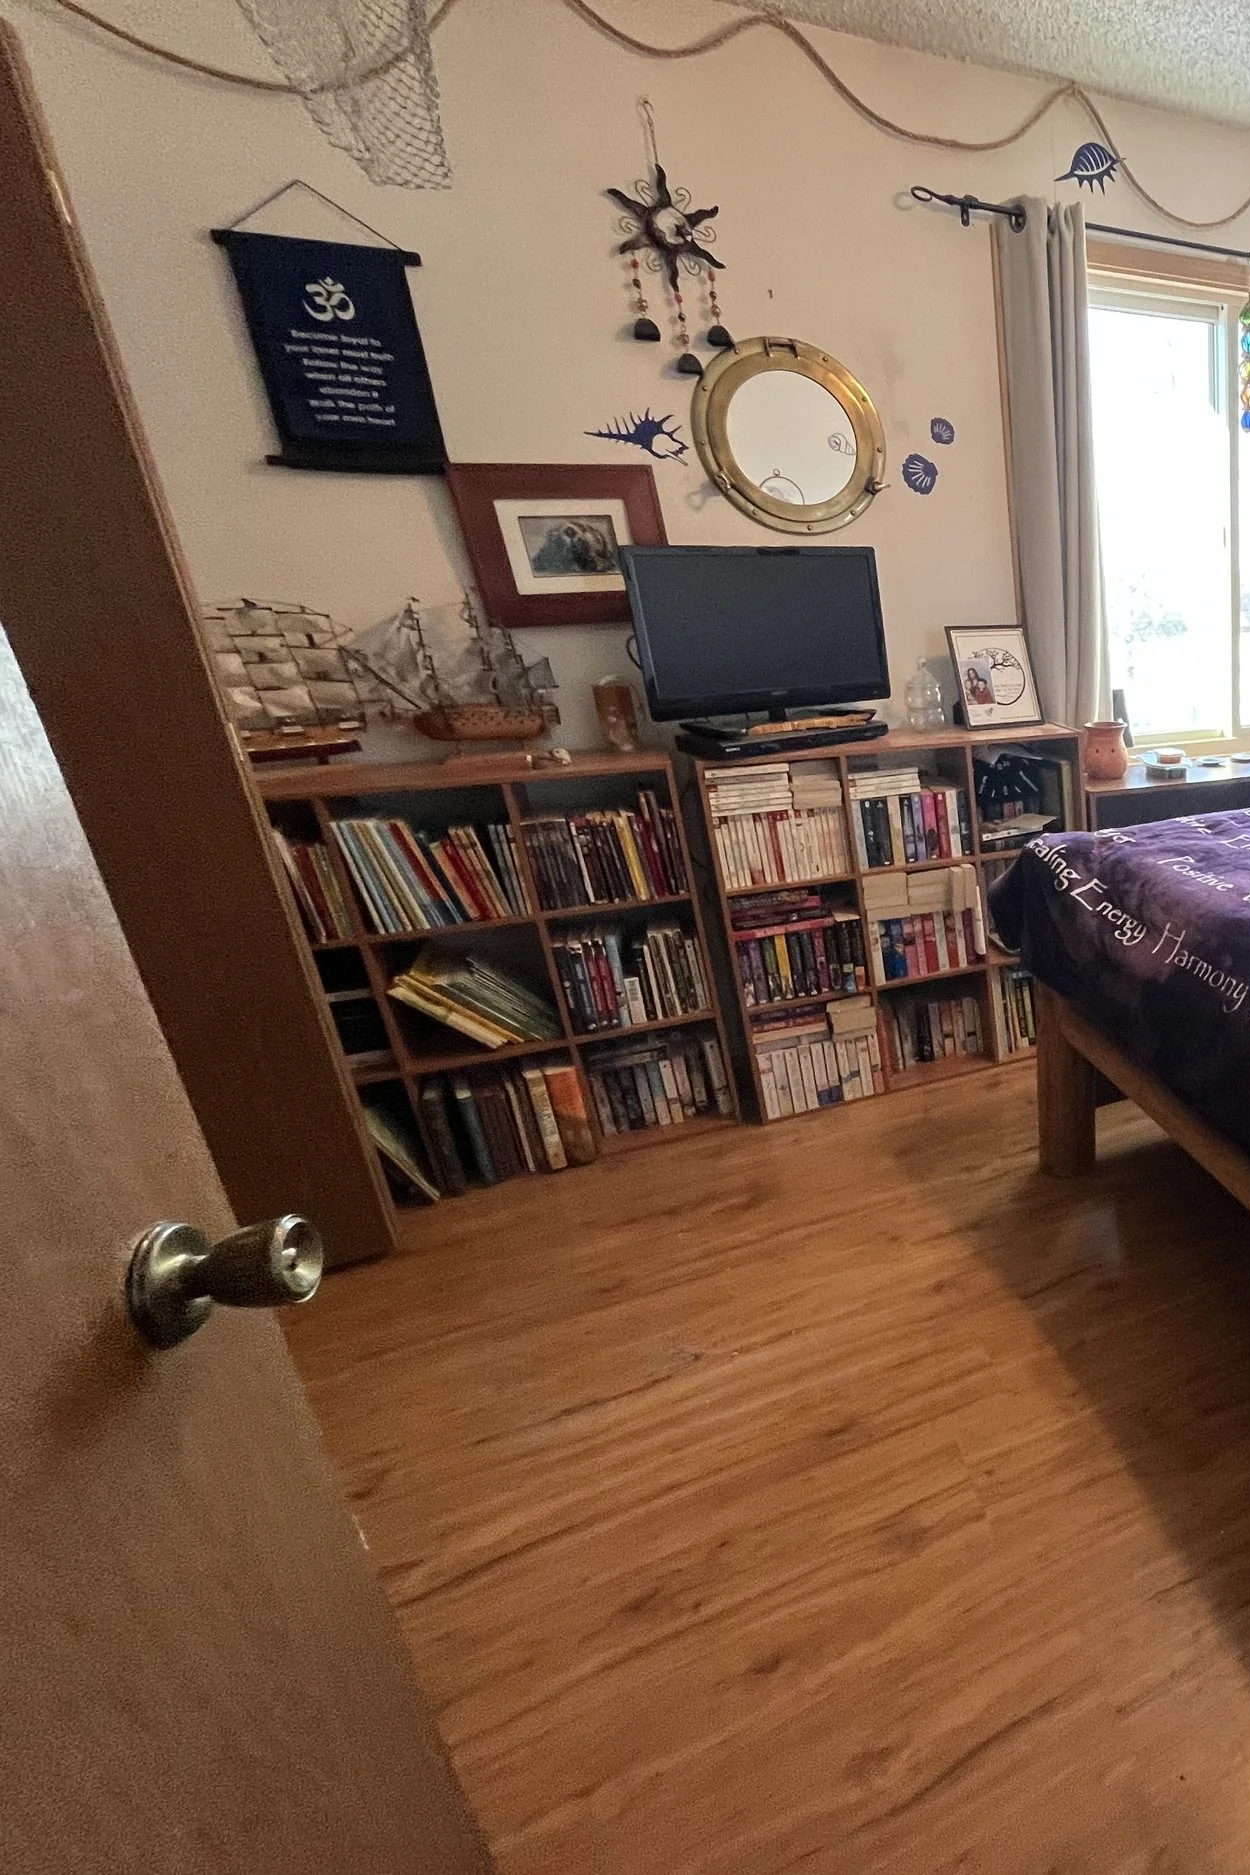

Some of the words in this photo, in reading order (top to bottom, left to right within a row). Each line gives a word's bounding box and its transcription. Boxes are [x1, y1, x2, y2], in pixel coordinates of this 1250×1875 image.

[1157, 855, 1235, 892] Positive
[1070, 878, 1147, 945] Energy
[1152, 922, 1250, 1014] Harmony
